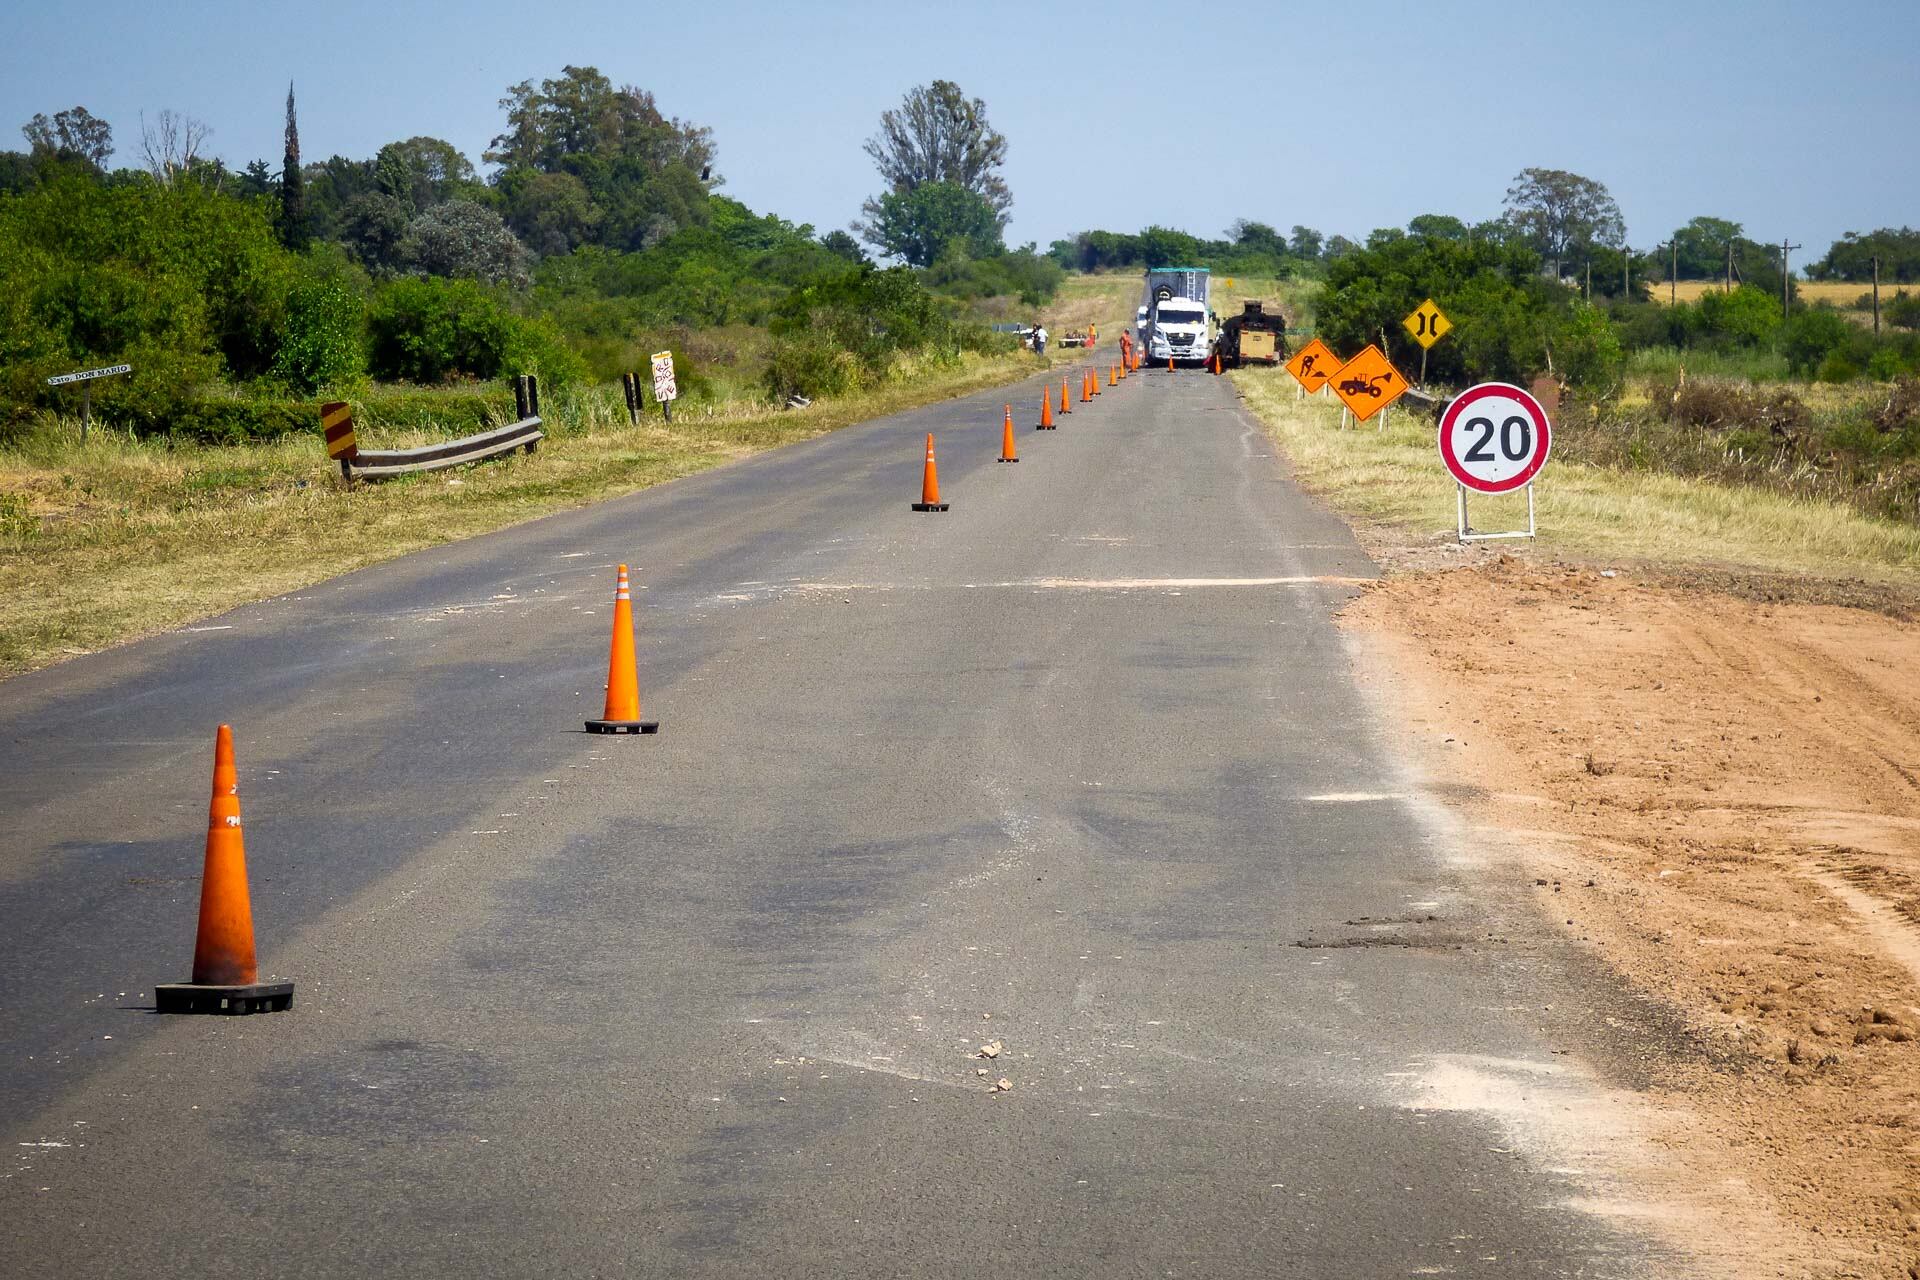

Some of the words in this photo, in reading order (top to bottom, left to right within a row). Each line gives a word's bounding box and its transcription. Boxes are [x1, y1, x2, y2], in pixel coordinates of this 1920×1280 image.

[75, 371, 95, 380] DON
[97, 365, 129, 376] MARIO
[1464, 415, 1531, 462] 20
